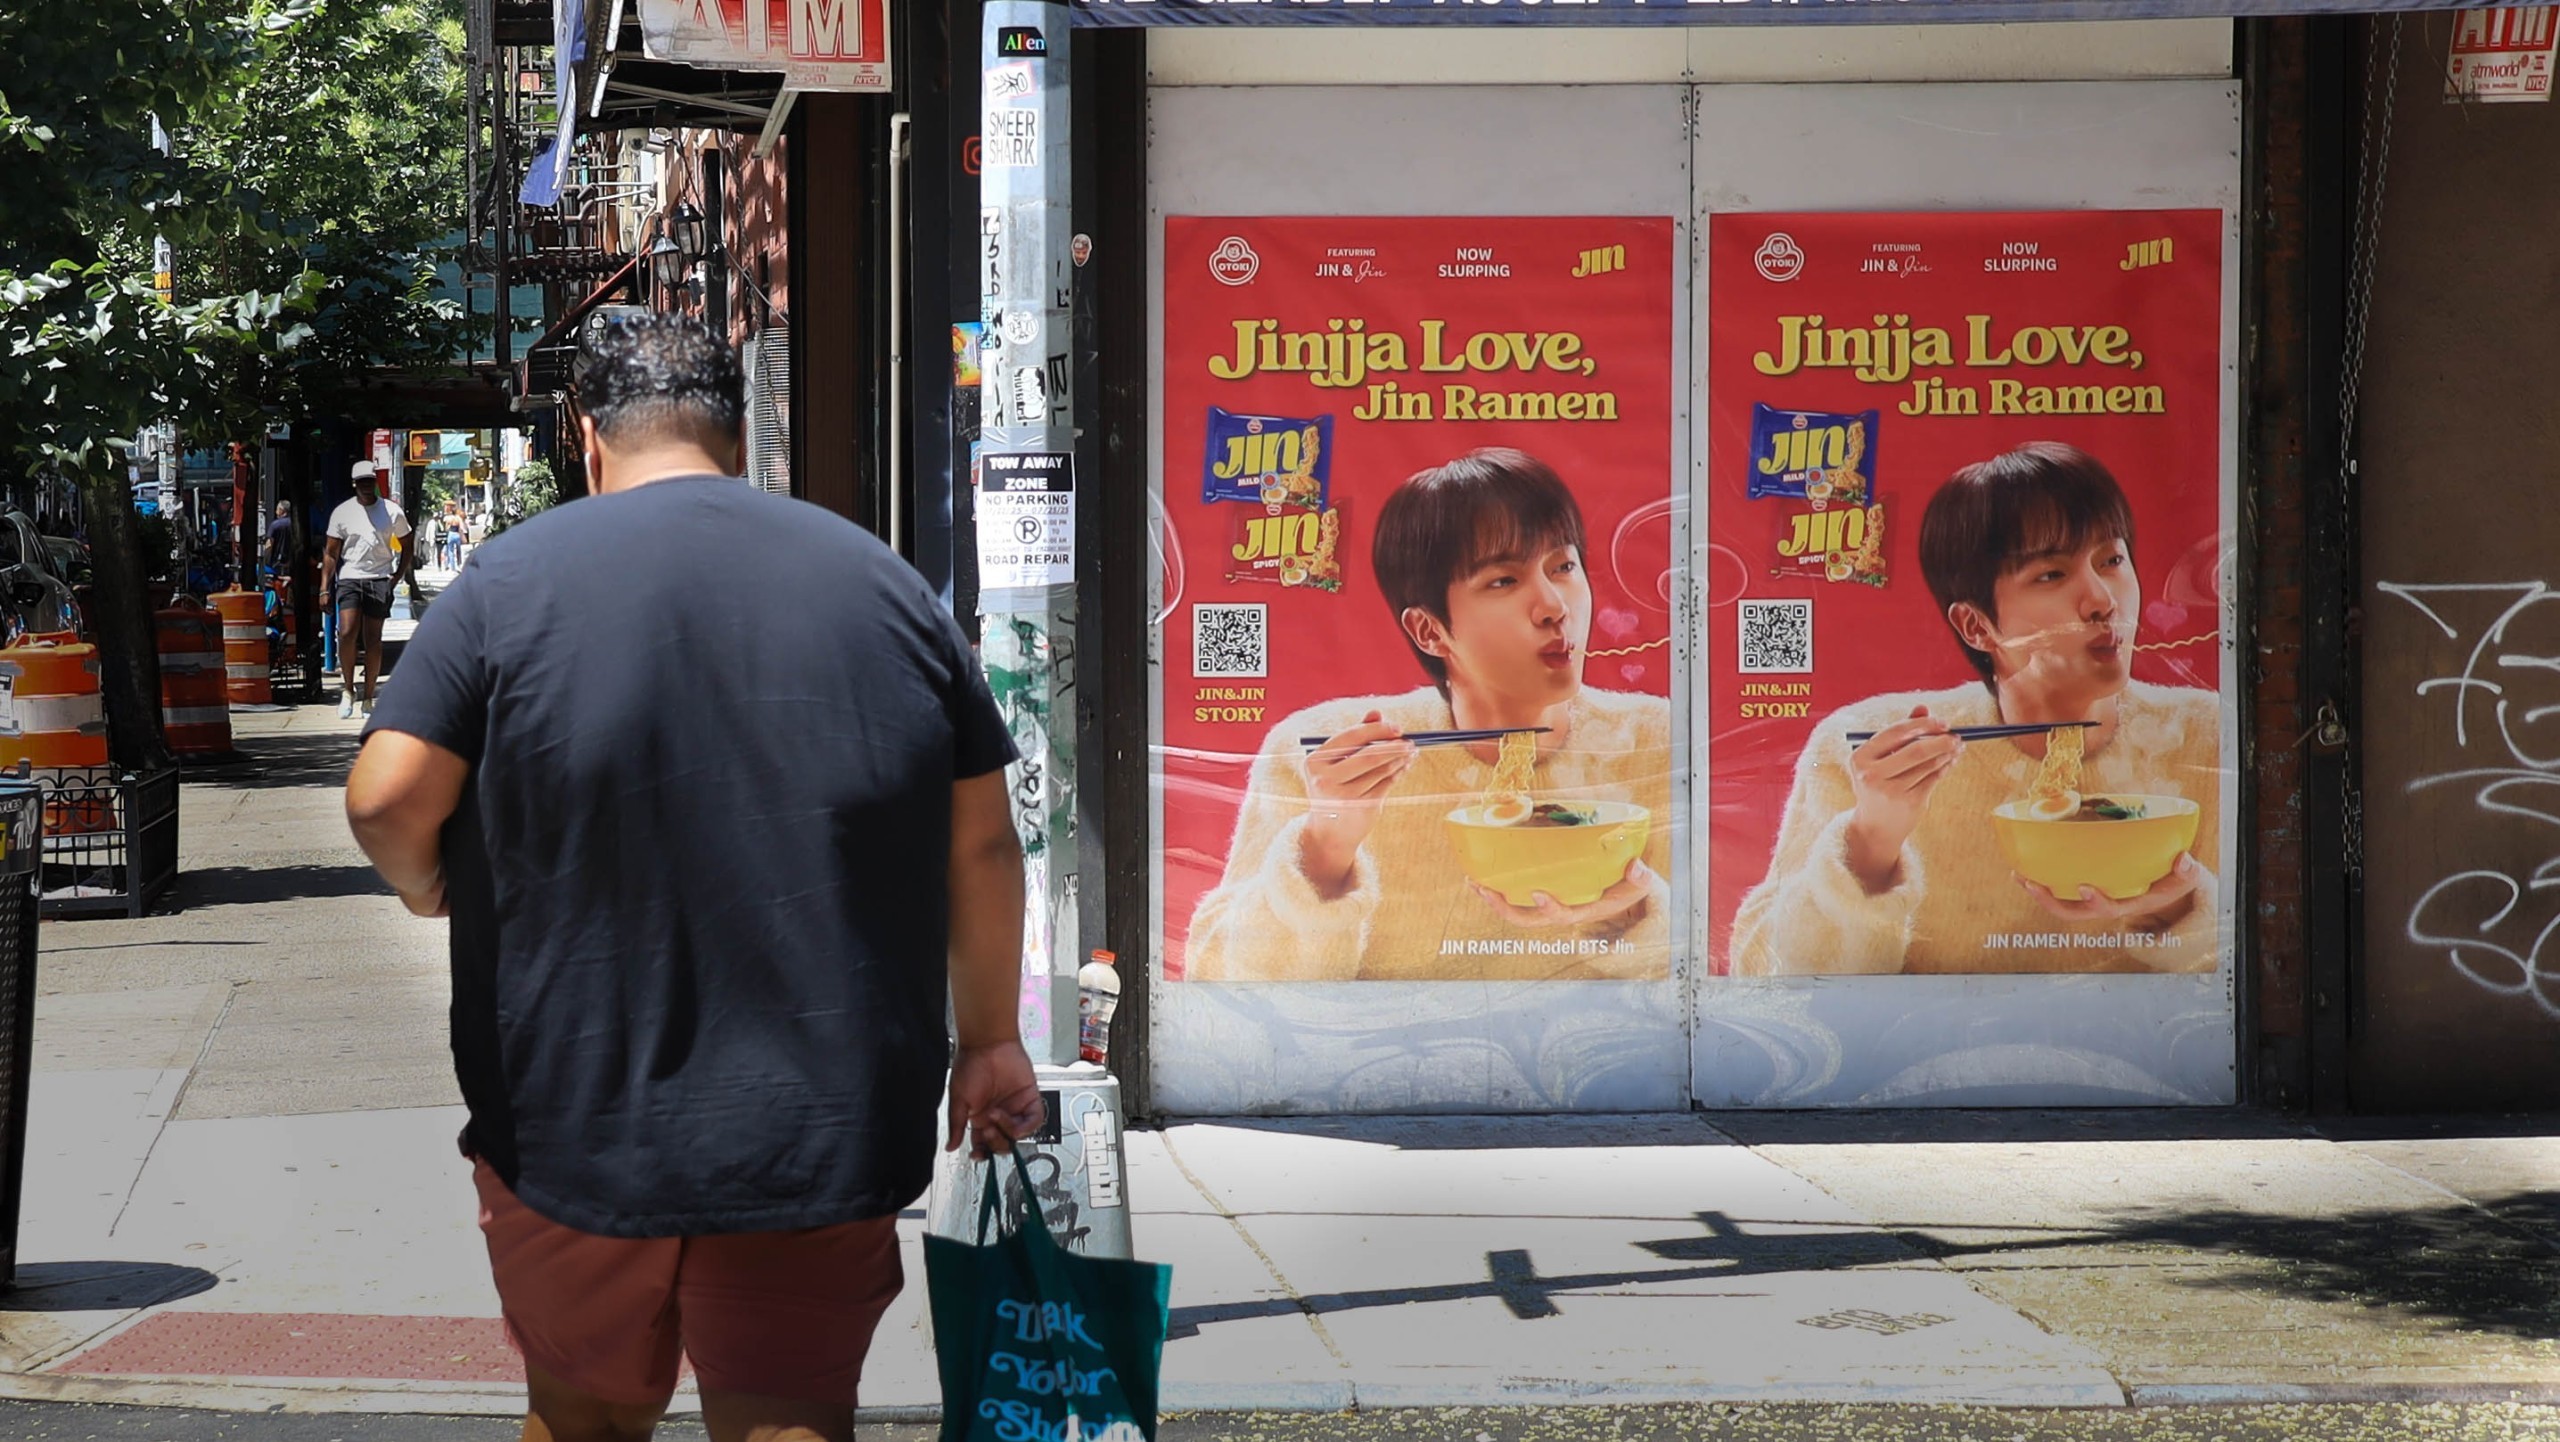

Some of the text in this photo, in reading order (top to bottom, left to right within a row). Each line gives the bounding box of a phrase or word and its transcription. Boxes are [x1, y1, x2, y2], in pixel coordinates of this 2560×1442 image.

[989, 111, 1036, 137] SMEER
[989, 138, 1035, 165] SHARK
[1327, 249, 1376, 257] FEATURING
[1457, 248, 1493, 261] NOW
[1872, 243, 1922, 252] FEATURING
[2002, 242, 2039, 255] NOW
[1315, 264, 1339, 277] JIN
[1342, 264, 1353, 277] &
[1438, 264, 1511, 278] SLURPING
[1860, 259, 1885, 272] JIN
[1887, 259, 1898, 272] &
[1984, 258, 2057, 272] SLURPING
[1418, 319, 1596, 376] Love,
[1964, 314, 2144, 370] Love,
[1353, 382, 1619, 420] Jin Ramen
[1898, 376, 2165, 416] Jin Ramen
[989, 456, 1063, 470] TOW AWAY
[1004, 478, 1048, 490] ZONE
[985, 494, 1068, 505] NO PARKING
[985, 554, 1069, 565] ROAD REPAIR
[1195, 687, 1266, 701] JIN&JIN
[1741, 683, 1811, 697] JIN&JIN
[1195, 706, 1266, 723] STORY
[1740, 702, 1811, 718] STORY
[1439, 938, 1635, 955] JIN RAMEN Model BTS Jin
[1983, 931, 2181, 949] JIN RAMEN Model BTS Jin
